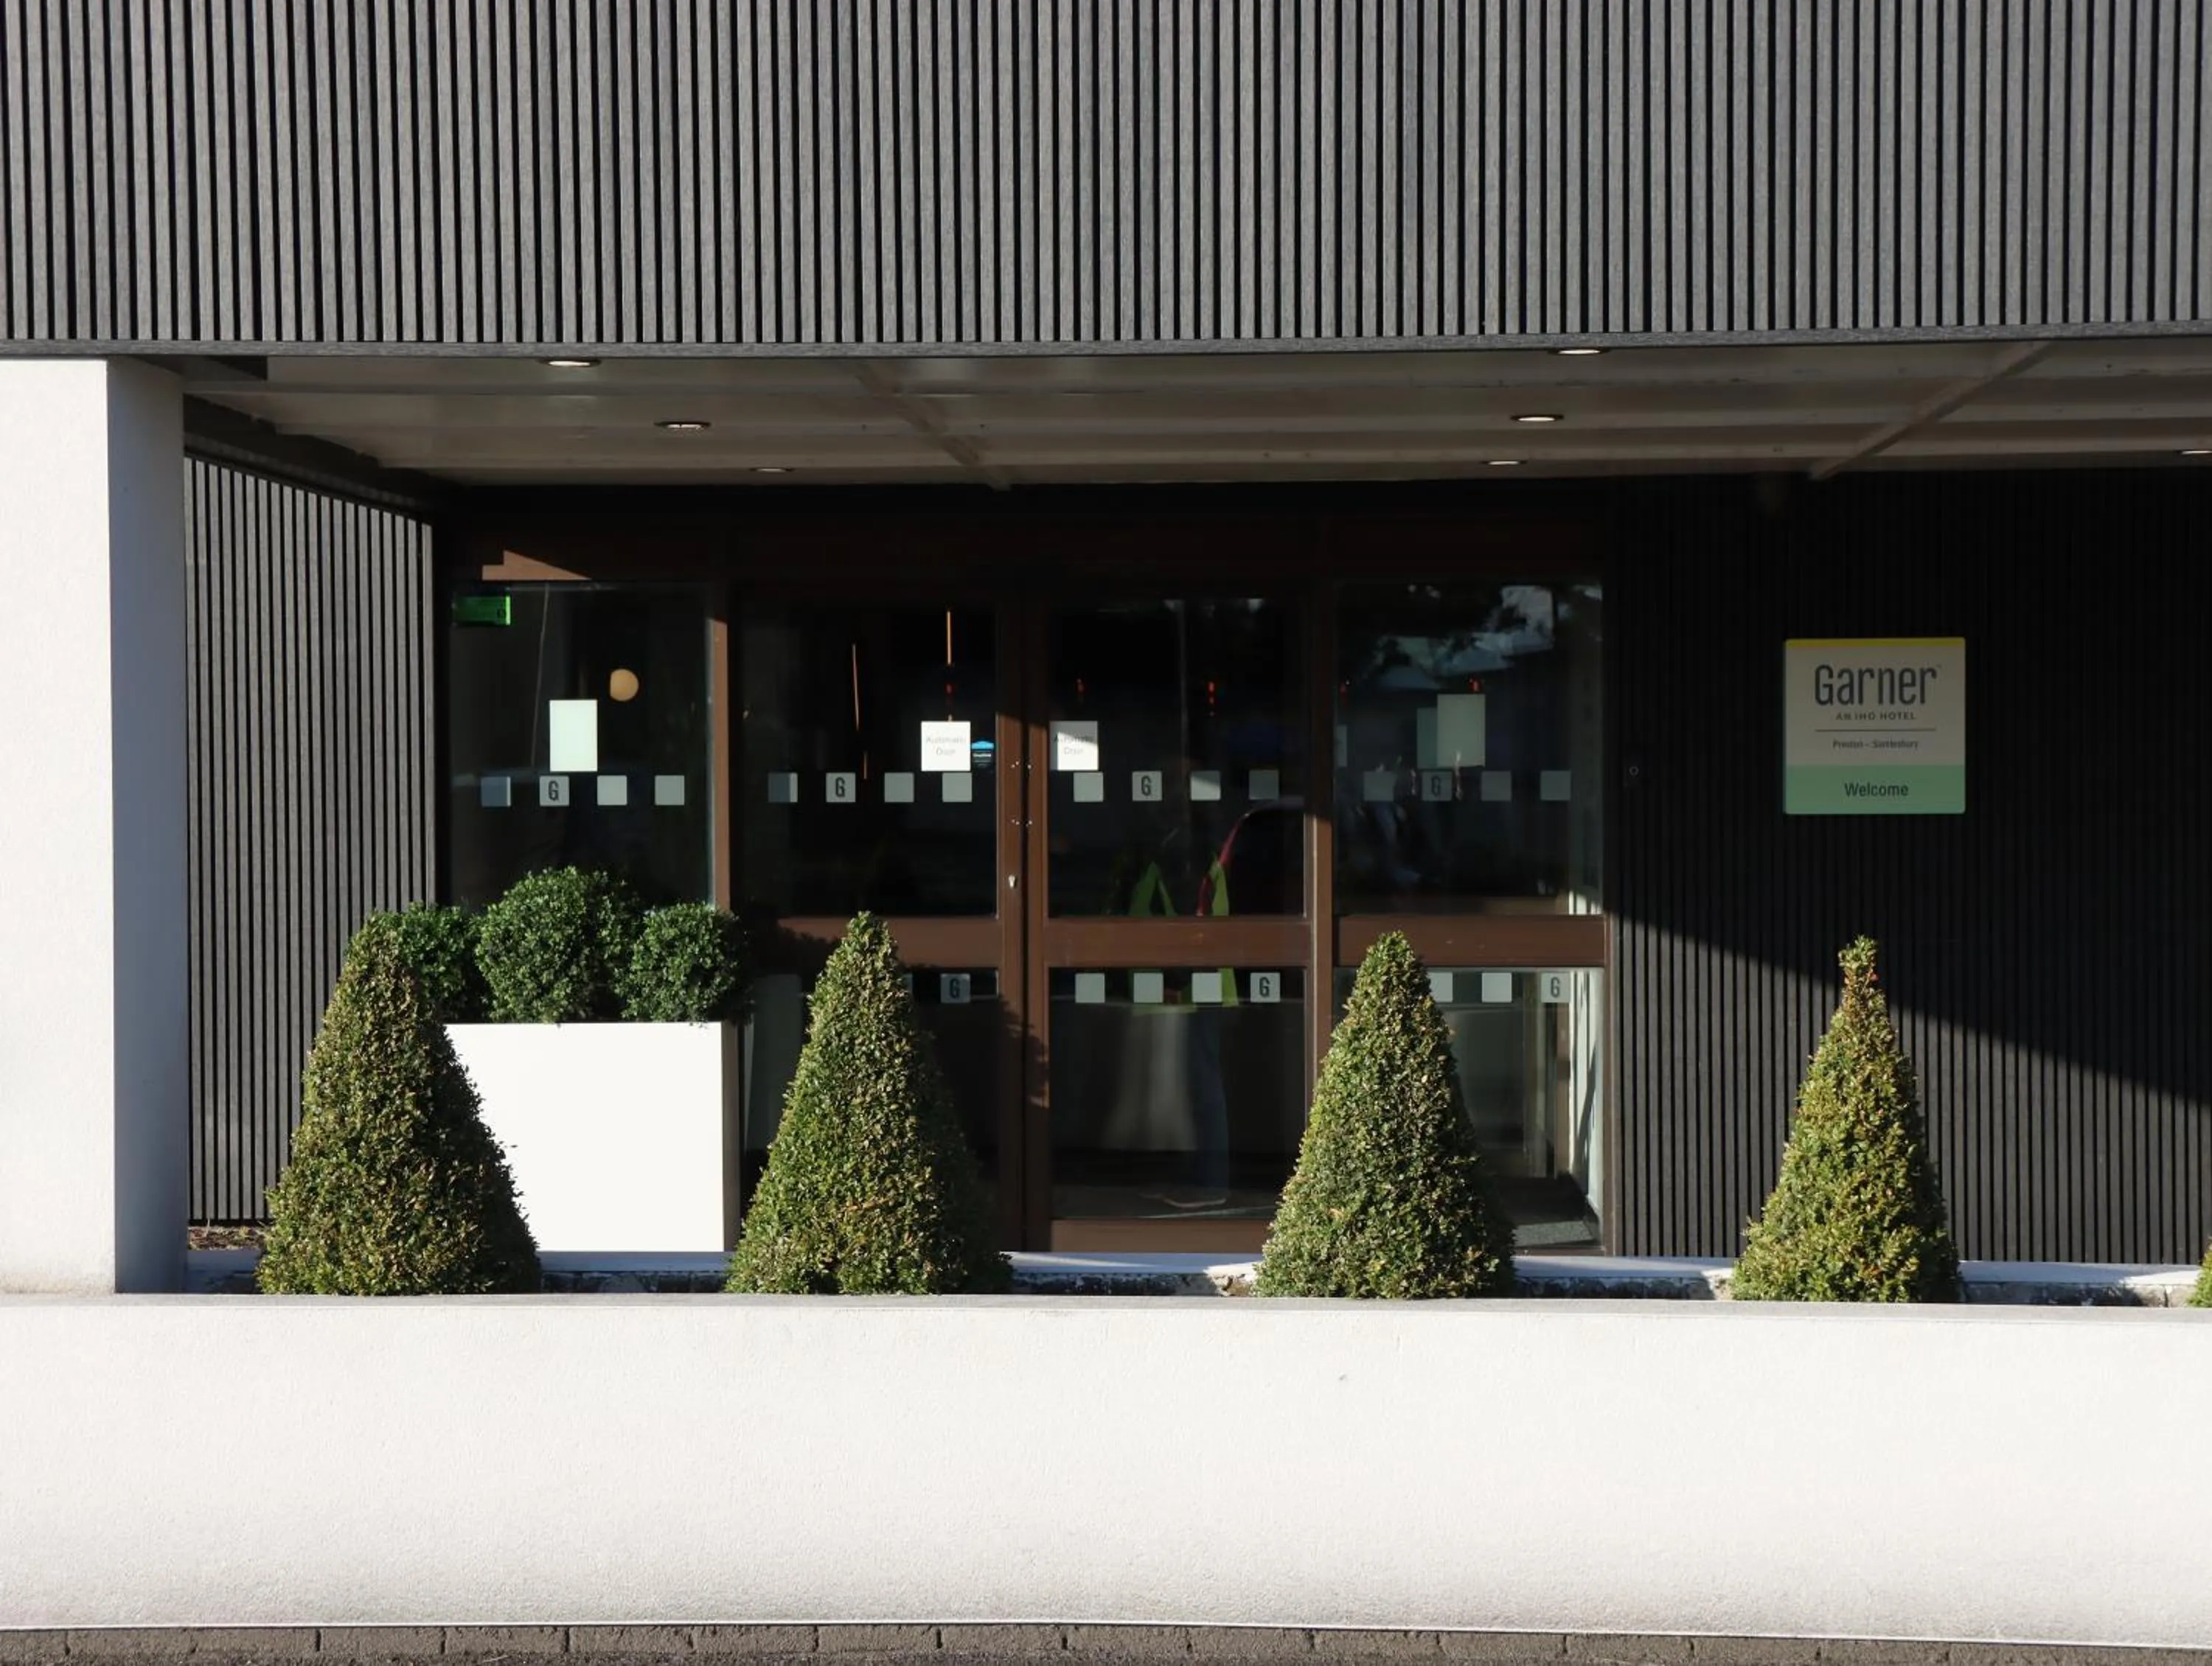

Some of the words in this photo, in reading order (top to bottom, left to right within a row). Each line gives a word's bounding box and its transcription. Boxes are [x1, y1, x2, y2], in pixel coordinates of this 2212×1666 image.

[1814, 664, 1938, 705] Garner
[1835, 711, 1851, 721] AN
[1879, 711, 1917, 721] HOTEL
[548, 780, 559, 801] G
[835, 776, 846, 798] G
[1141, 775, 1152, 796] G
[1844, 782, 1909, 797] Welcome
[949, 977, 960, 999] G
[1259, 976, 1270, 997] G
